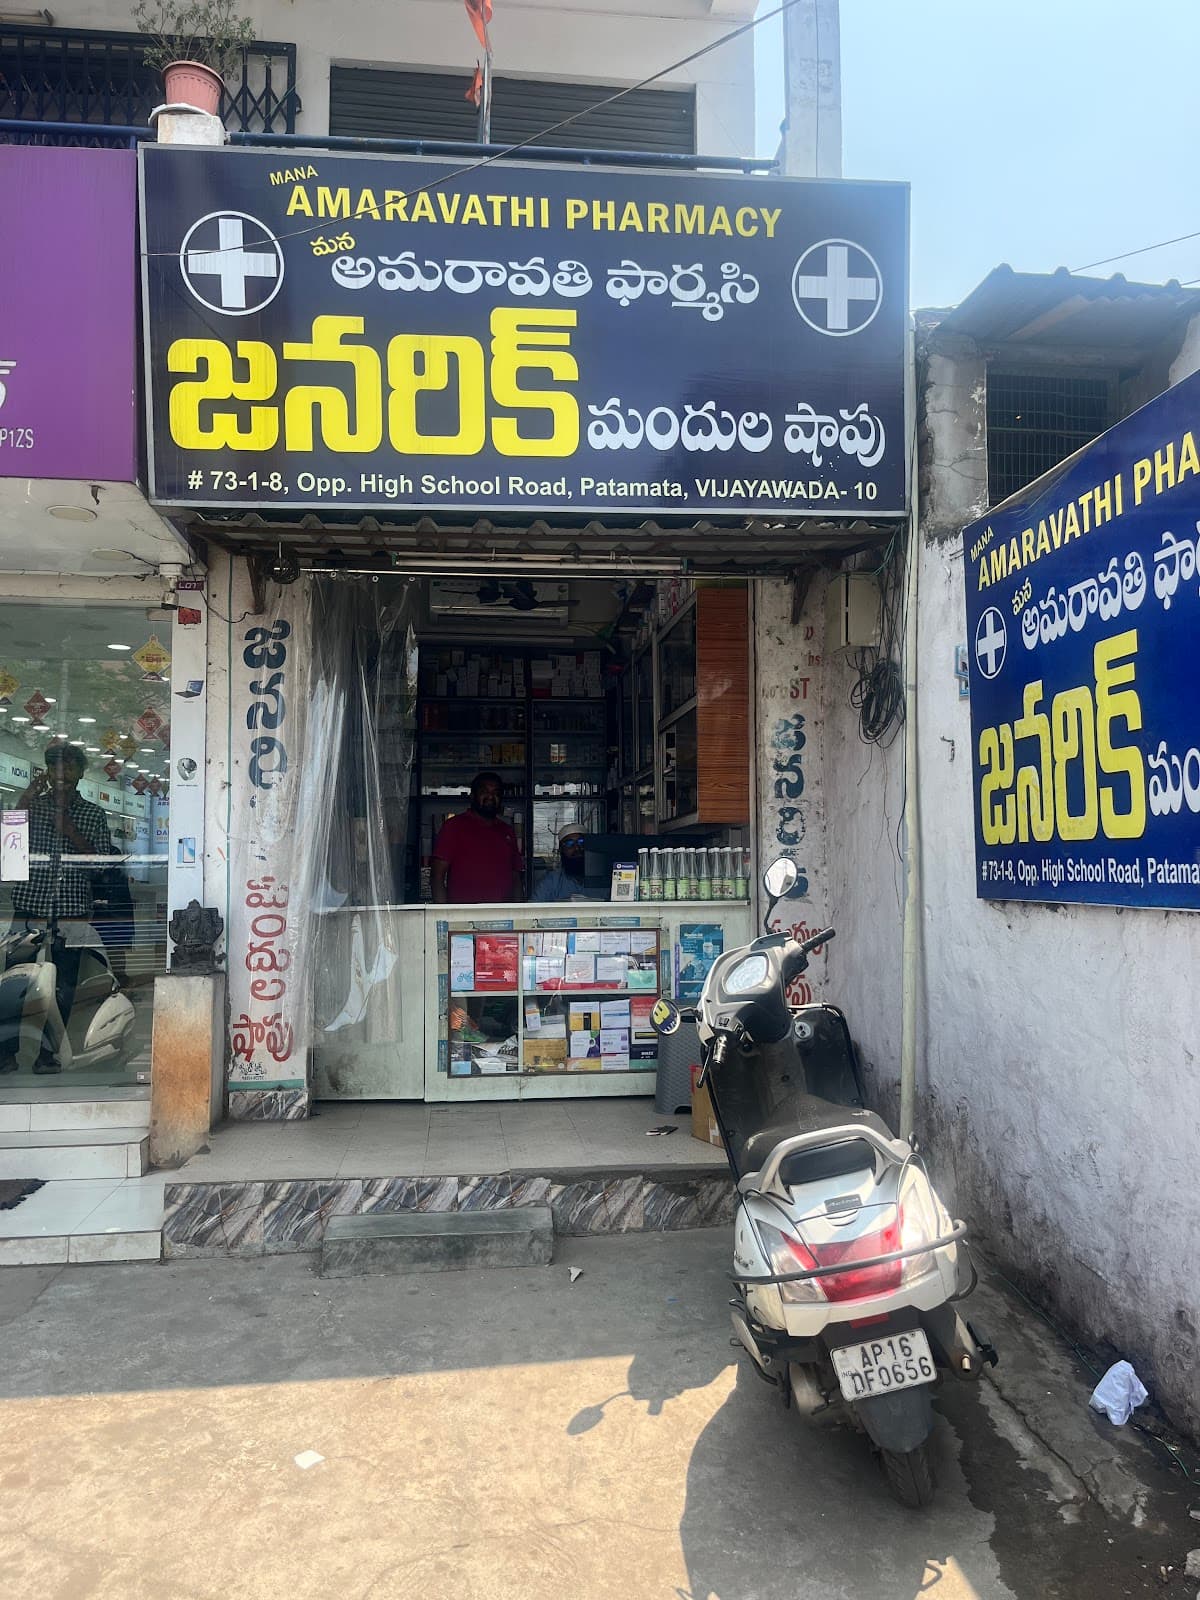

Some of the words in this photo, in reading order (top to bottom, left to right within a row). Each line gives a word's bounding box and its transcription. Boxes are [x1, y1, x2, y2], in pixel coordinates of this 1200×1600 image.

[269, 165, 319, 186] MANA
[286, 185, 549, 229] AMARAVATHI
[566, 199, 782, 238] PHARMACY
[310, 232, 356, 256] మన
[331, 251, 593, 298] అమరావతి
[605, 260, 760, 322] ఫార్మసి
[587, 397, 772, 453] మందుల
[783, 402, 886, 468] షాపు
[188, 470, 203, 490] #
[210, 470, 290, 494] 73-1-8,
[297, 474, 353, 497] Opp.
[361, 475, 414, 498] High
[421, 477, 502, 496] School
[508, 477, 573, 499] Road,
[580, 478, 689, 500] Patamata,
[854, 482, 878, 500] 10
[970, 526, 995, 562] MANA
[977, 473, 1123, 591] AMARAVATHI
[1011, 576, 1033, 616] మన
[1021, 551, 1147, 650] అమరావతి
[989, 860, 1016, 883] 73-1-8,
[1017, 861, 1040, 887] Opp.
[1042, 860, 1065, 889] High
[1066, 858, 1105, 883] School
[1108, 858, 1144, 888] Road,
[860, 1343, 883, 1369] AP
[888, 1336, 912, 1360] 16
